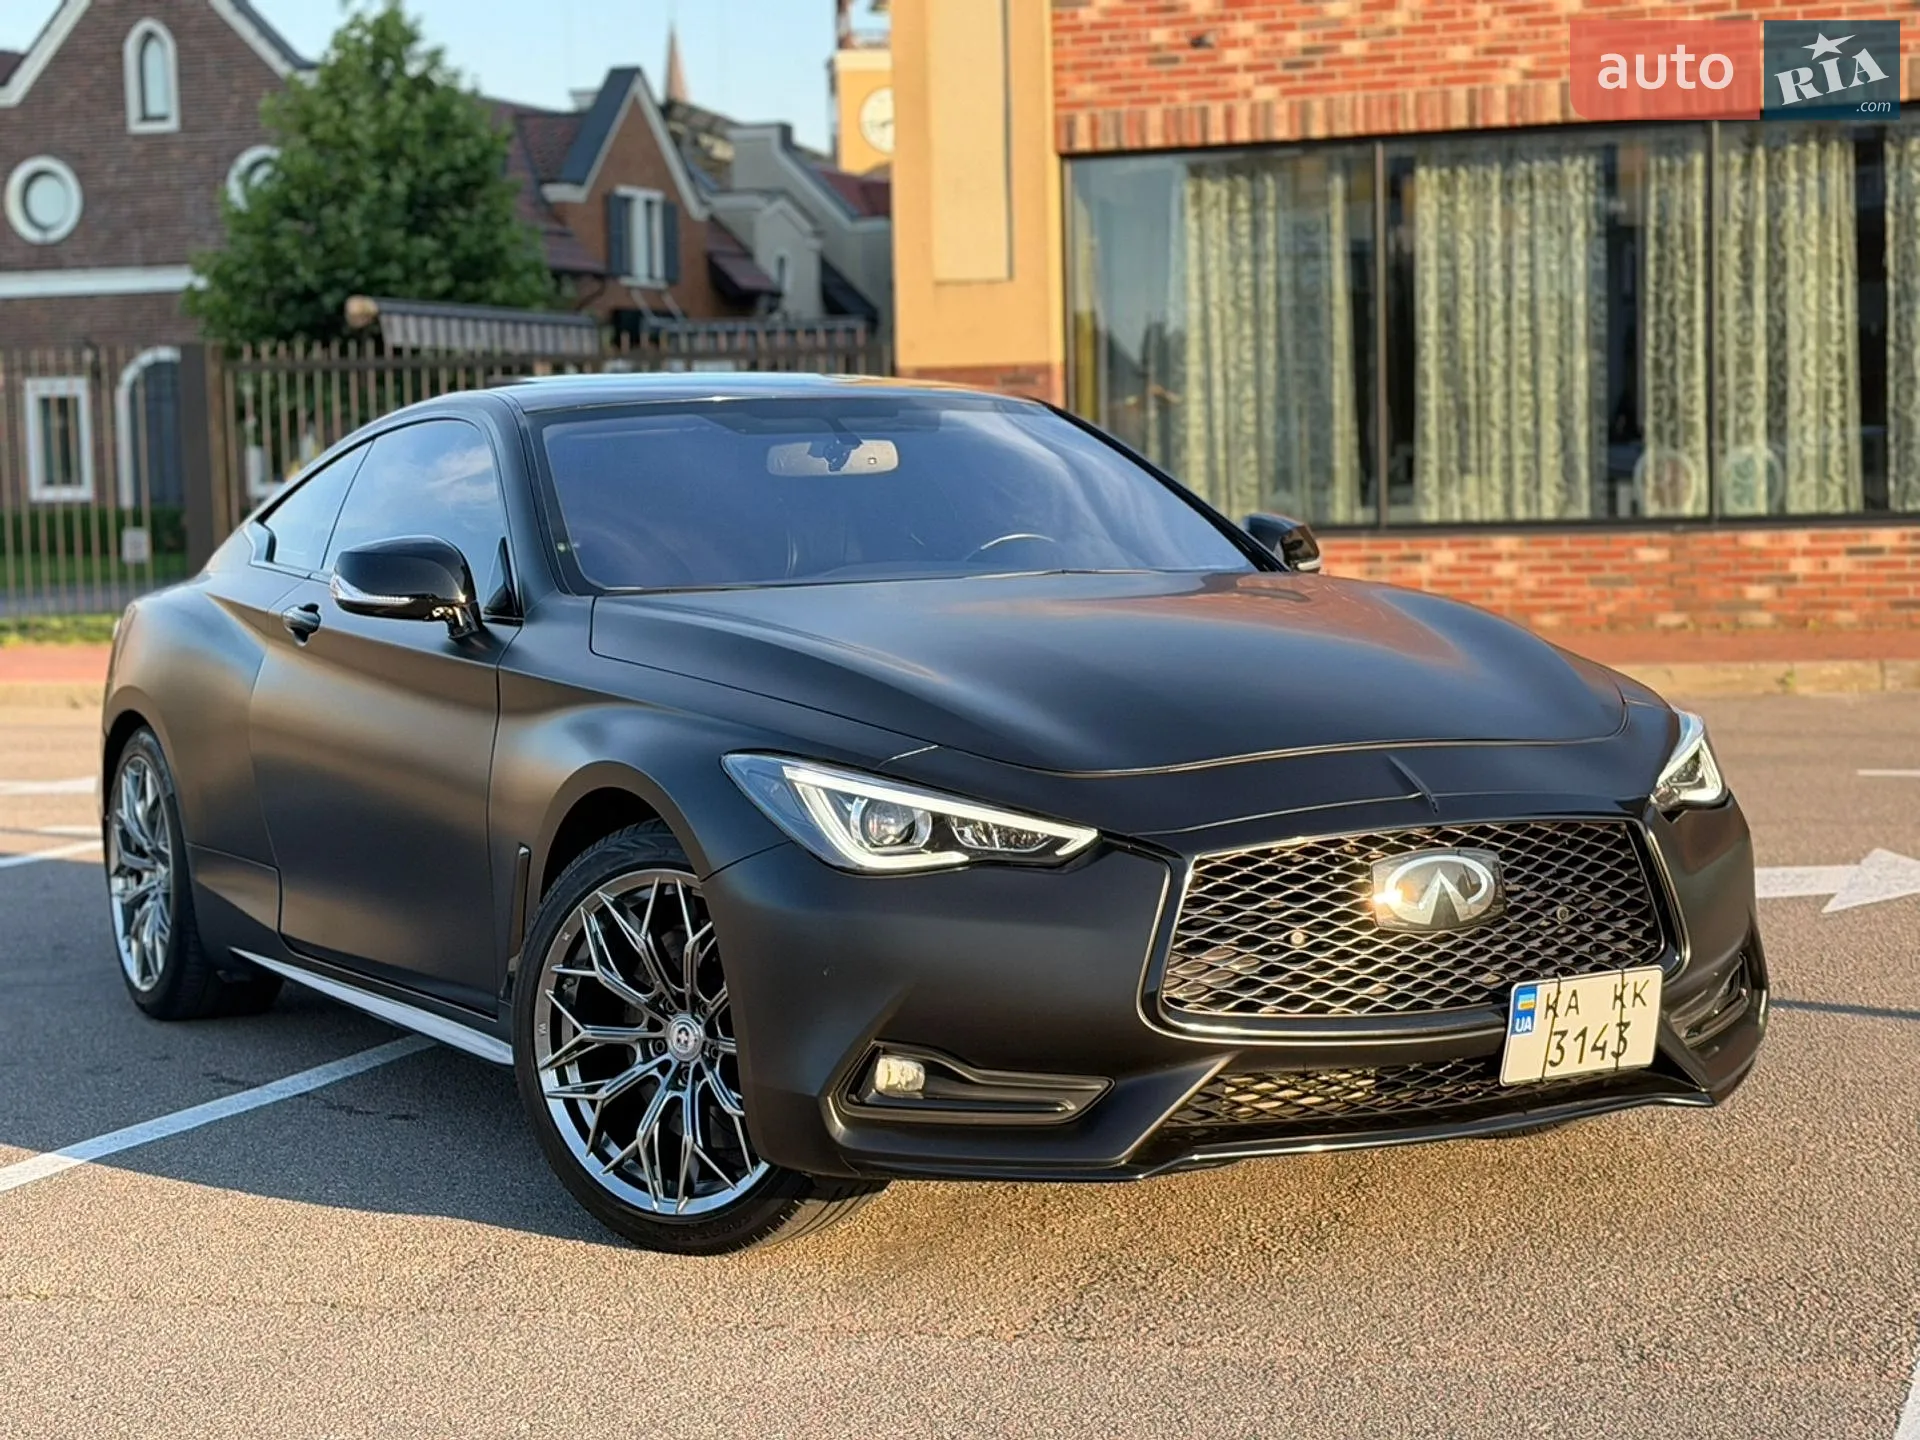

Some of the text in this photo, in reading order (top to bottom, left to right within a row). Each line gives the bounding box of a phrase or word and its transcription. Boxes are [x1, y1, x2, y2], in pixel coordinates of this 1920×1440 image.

[1544, 979, 1650, 1019] KA KK
[1515, 1018, 1532, 1033] UA
[1548, 1021, 1631, 1067] 3143
